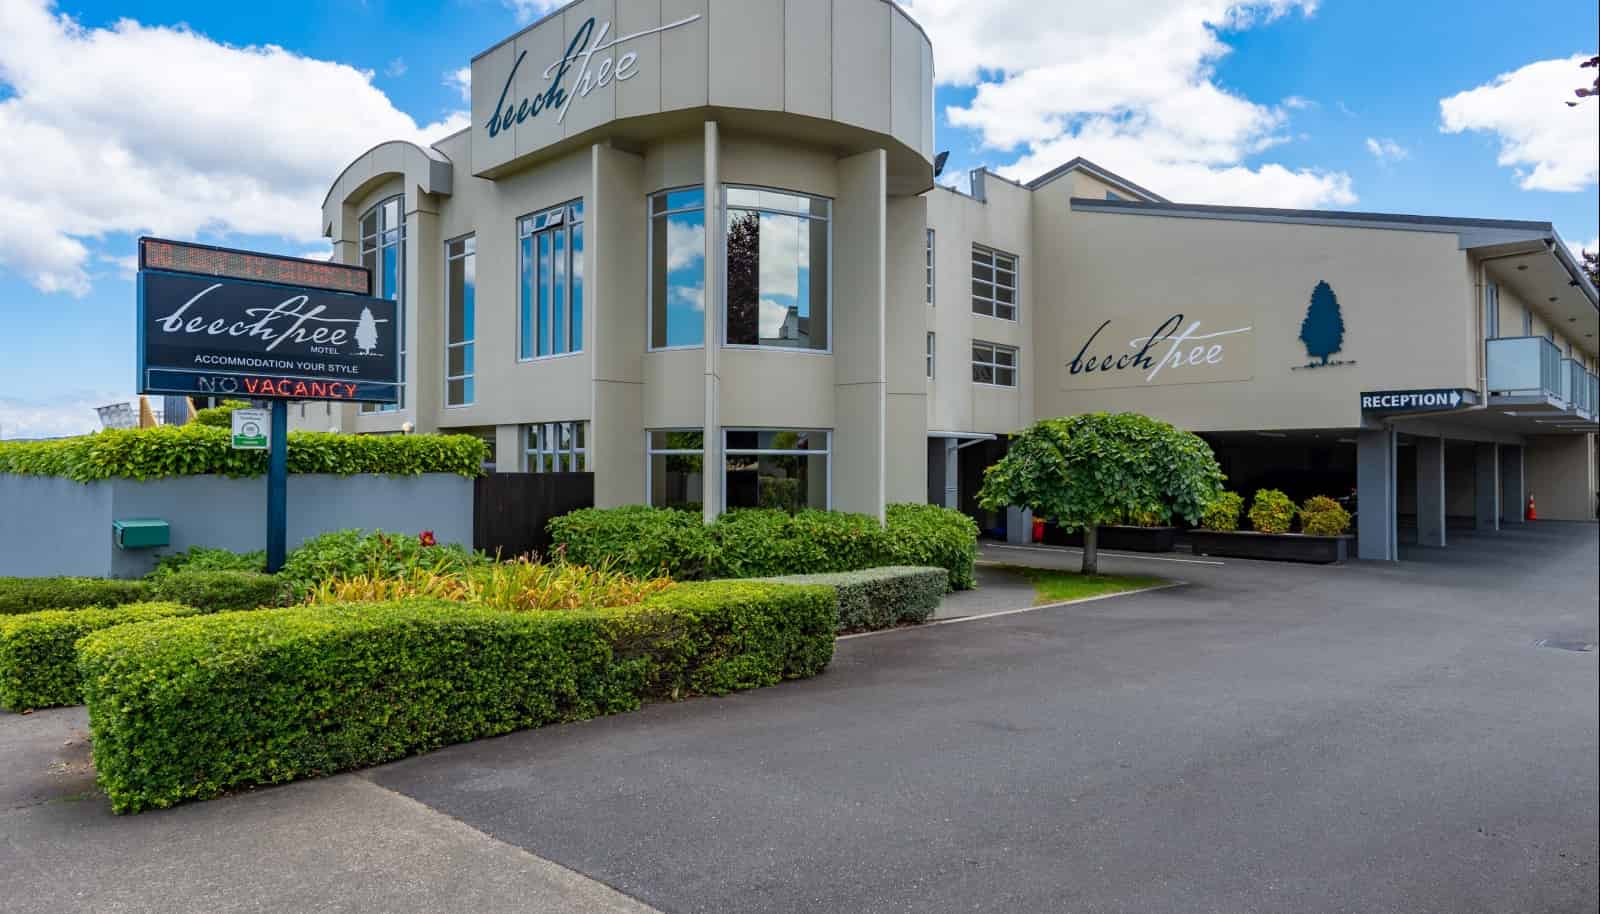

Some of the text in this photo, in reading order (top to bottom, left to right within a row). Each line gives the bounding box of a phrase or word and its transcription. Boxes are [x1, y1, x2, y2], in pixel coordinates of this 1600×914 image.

[310, 346, 340, 355] MOTEL
[194, 354, 359, 374] ACCOMMODATION YOUR STYLE
[198, 376, 357, 398] NO VACANCY
[1362, 393, 1448, 408] RECEPTION
